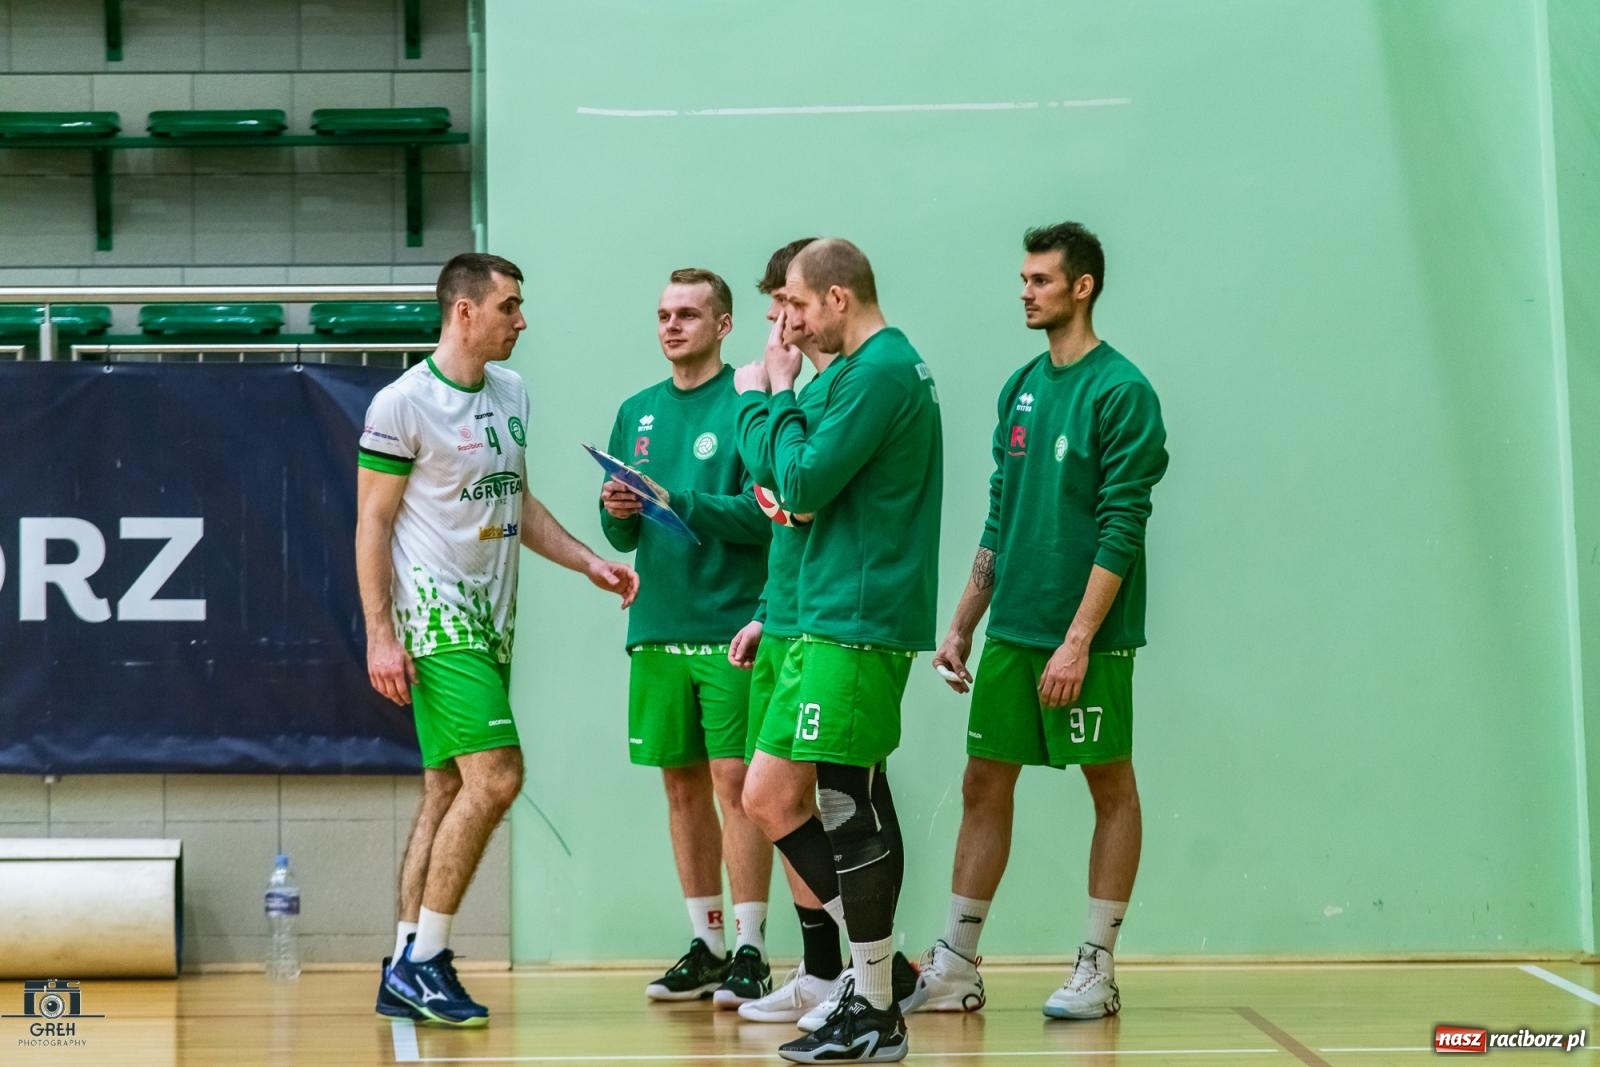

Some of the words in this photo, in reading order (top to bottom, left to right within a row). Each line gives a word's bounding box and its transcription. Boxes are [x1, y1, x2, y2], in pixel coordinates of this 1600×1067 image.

[485, 426, 502, 455] 4
[634, 436, 650, 457] R
[1010, 425, 1026, 448] R
[459, 478, 523, 502] AGROTEA
[0, 517, 207, 623] RZ
[795, 702, 821, 742] 13
[1069, 706, 1103, 744] 97
[707, 910, 723, 925] R
